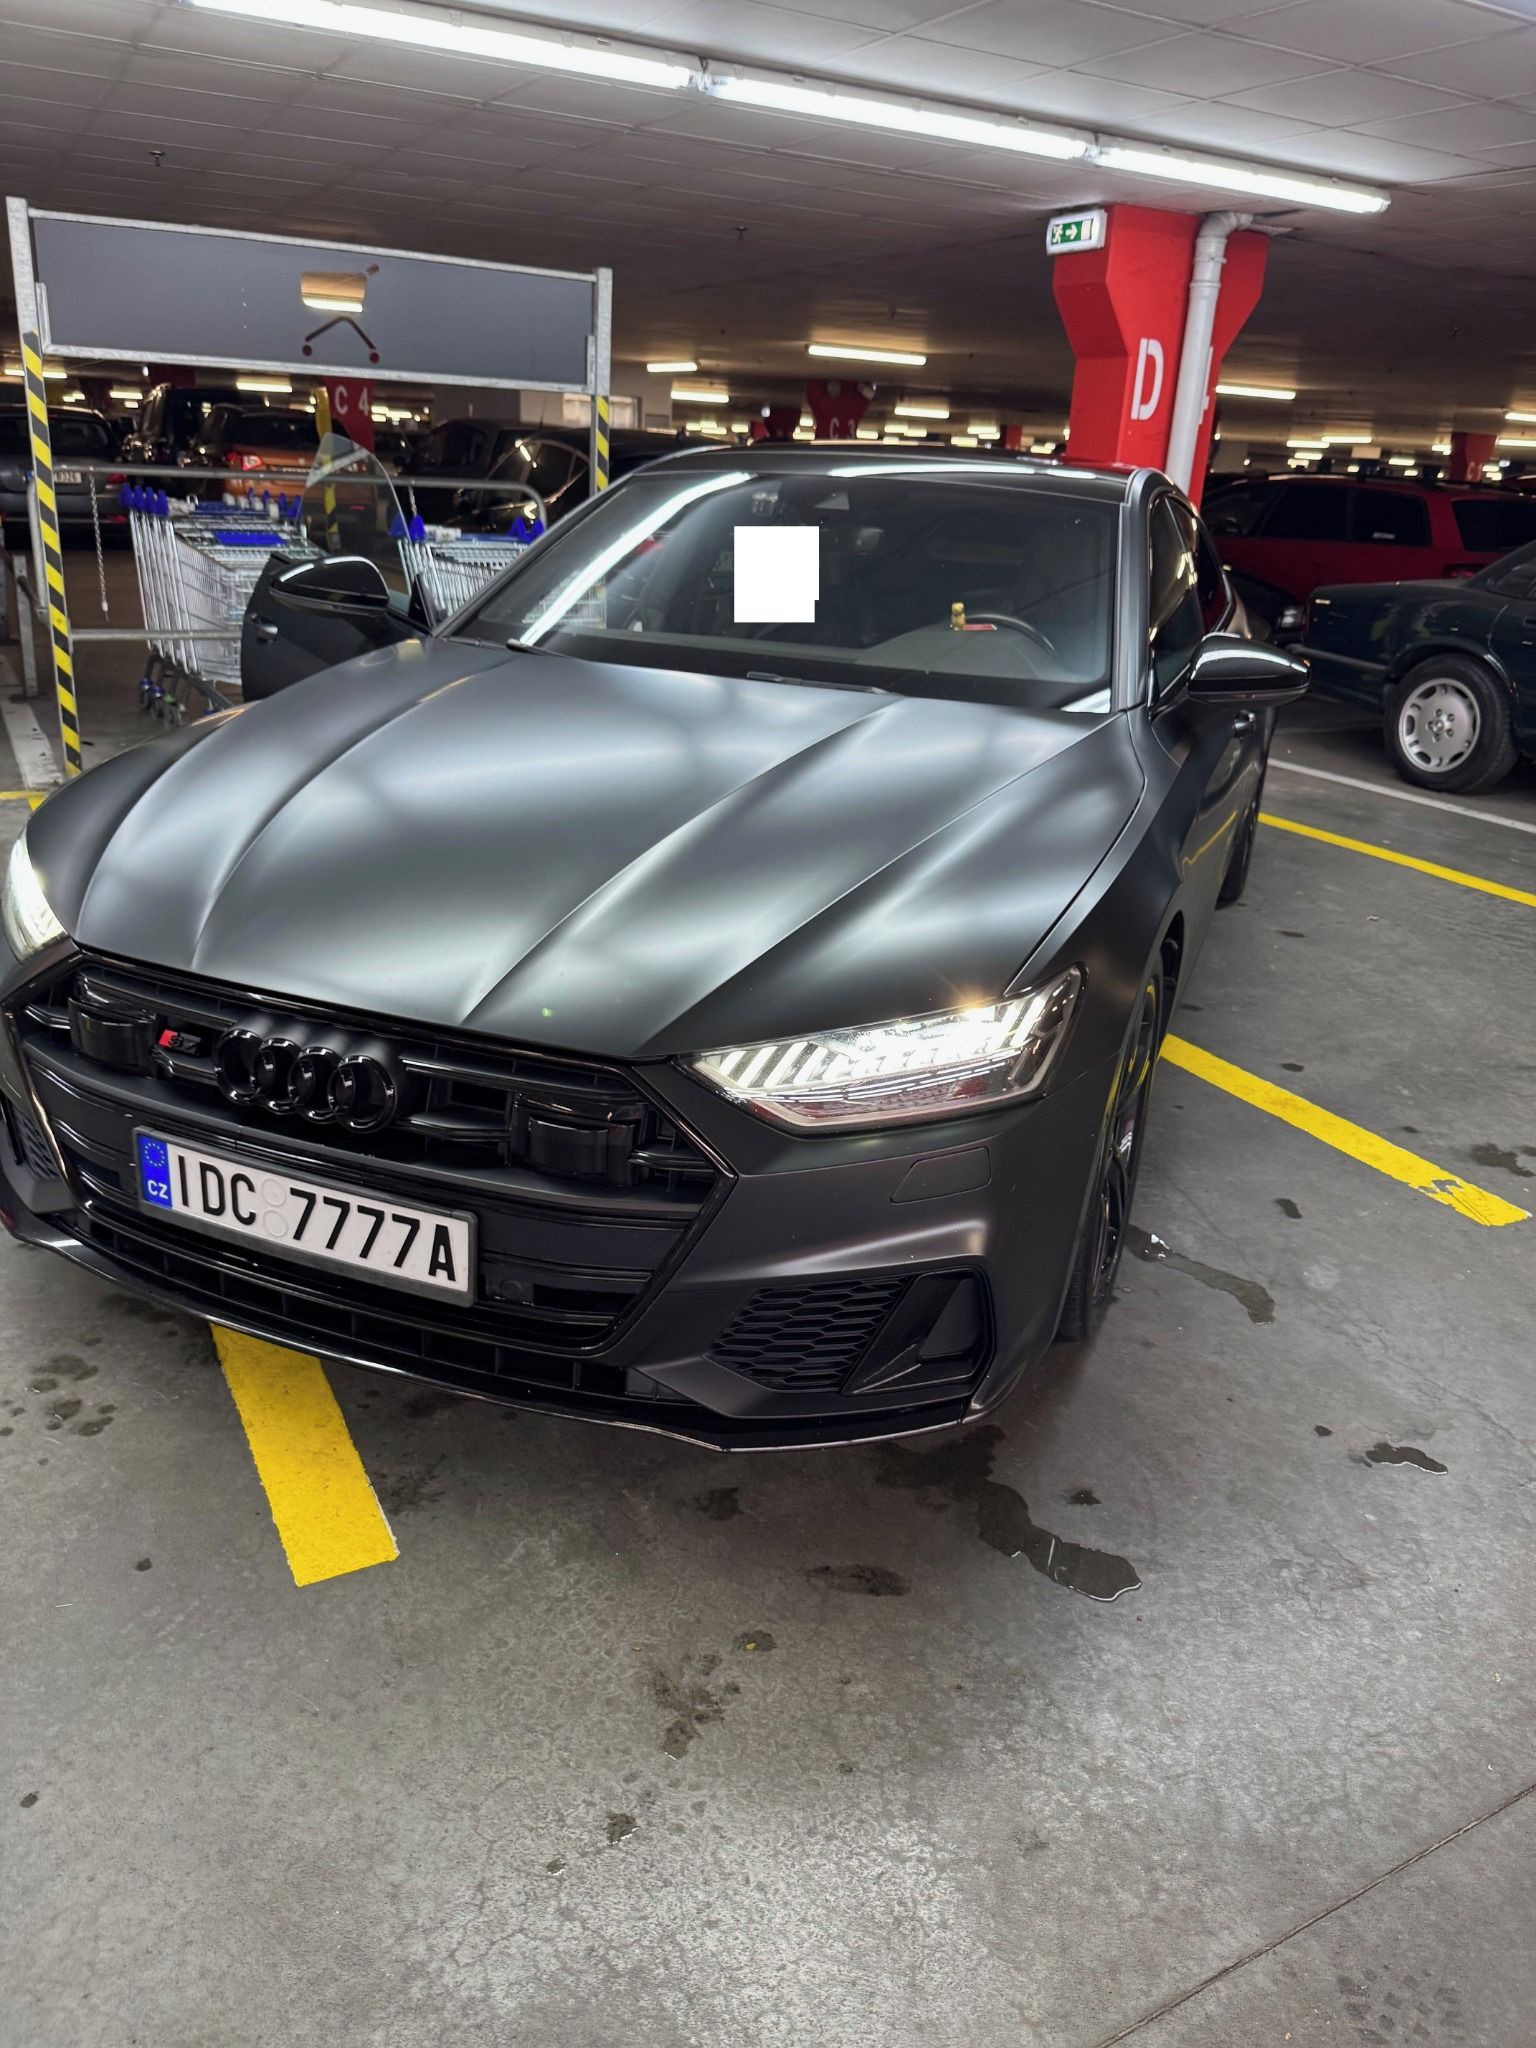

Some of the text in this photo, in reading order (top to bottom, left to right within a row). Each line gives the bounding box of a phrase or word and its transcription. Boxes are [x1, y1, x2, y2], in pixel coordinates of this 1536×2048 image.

[335, 385, 370, 417] C 4
[1130, 337, 1164, 421] D
[147, 1179, 169, 1200] CZ
[289, 1186, 457, 1282] 7777A
